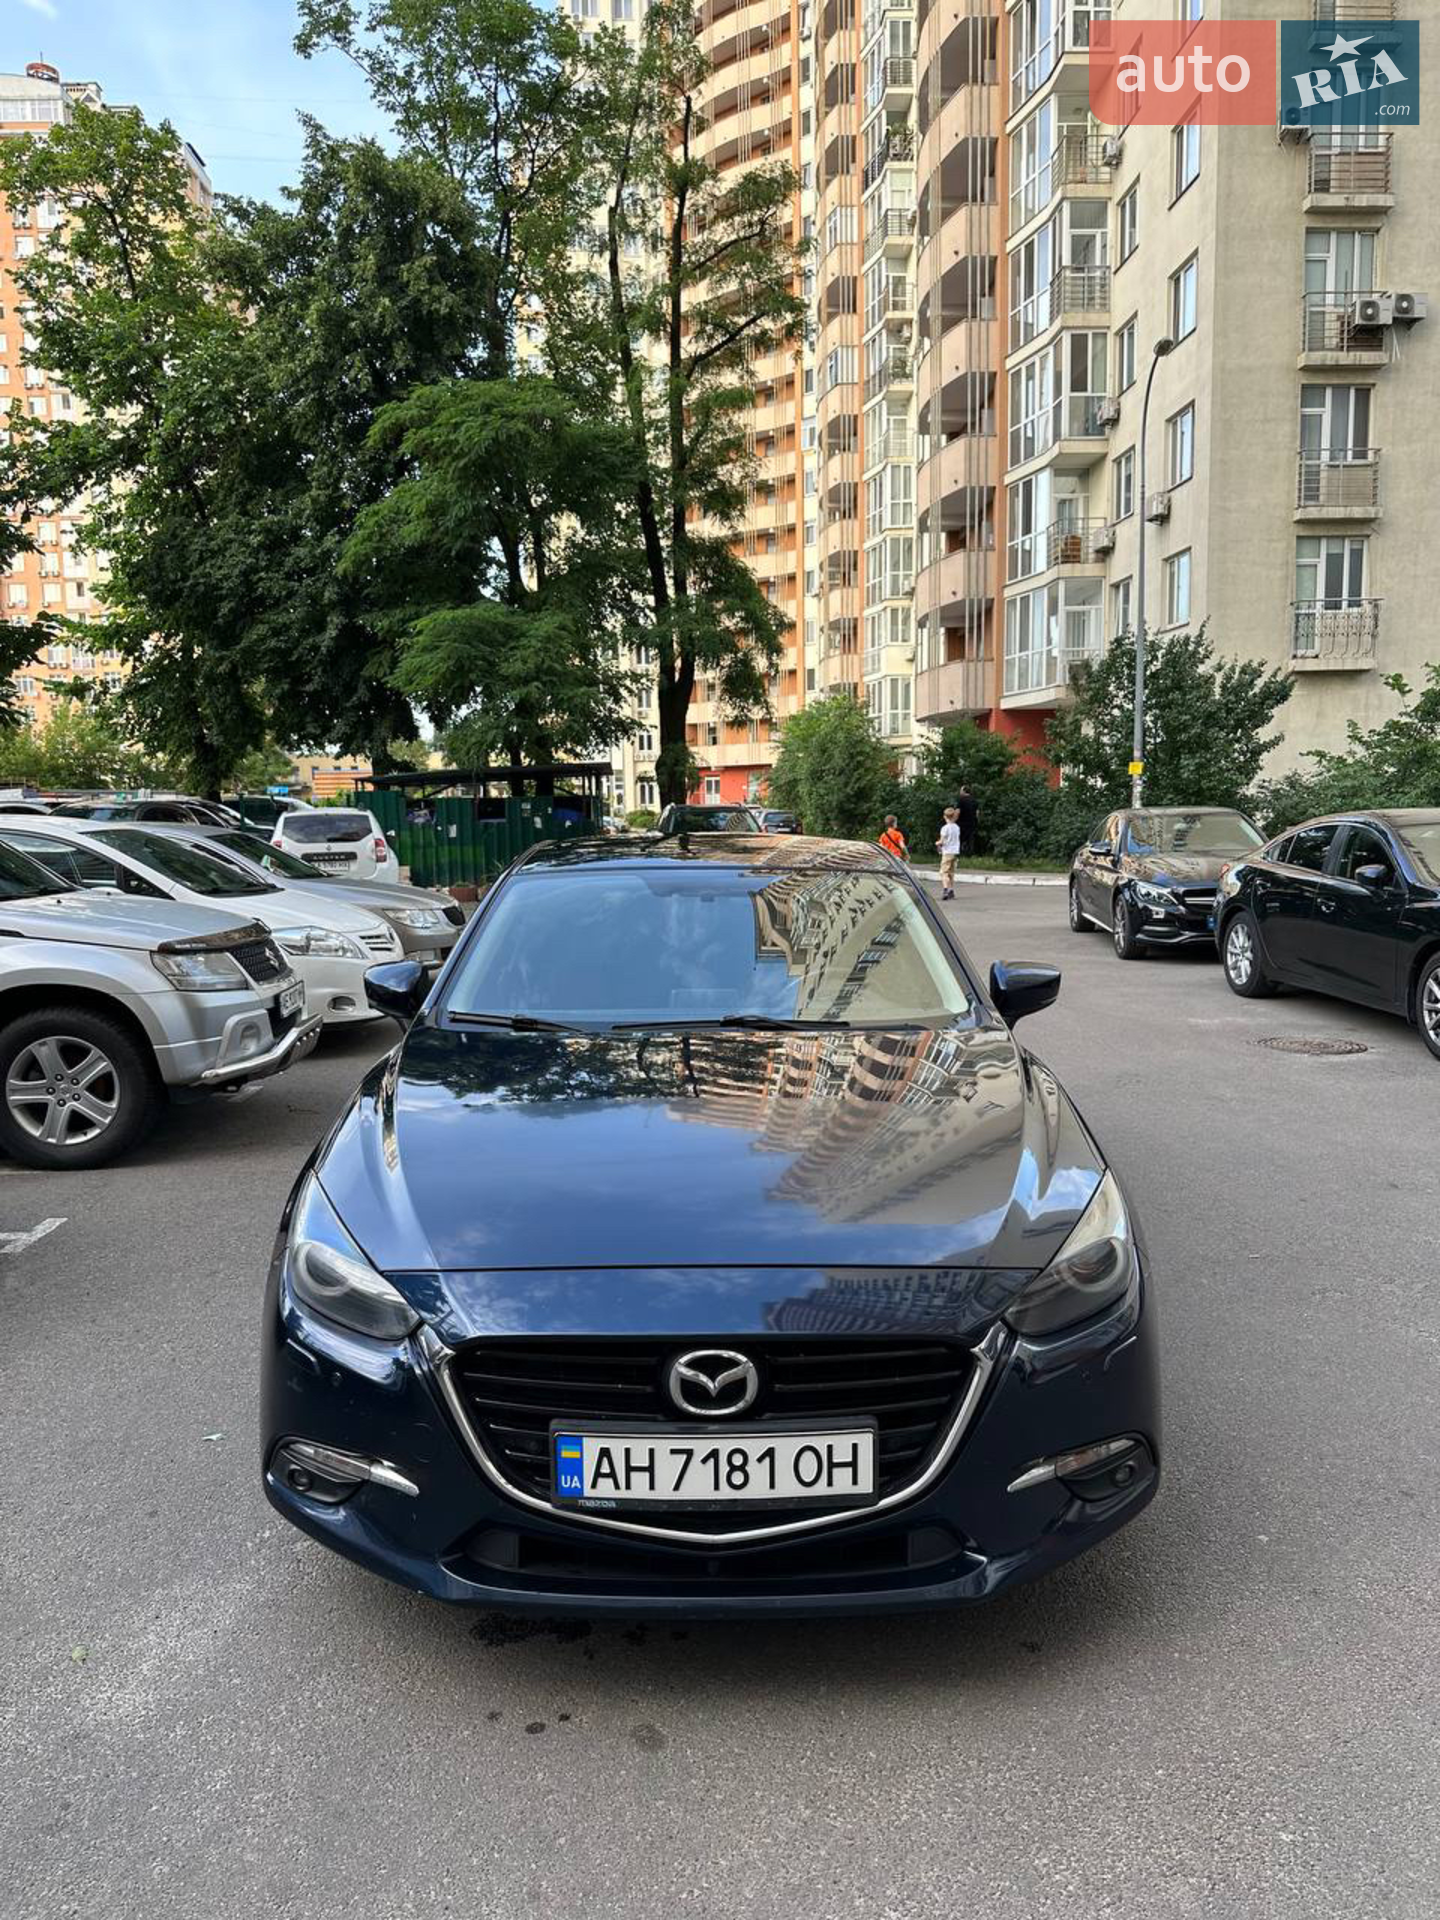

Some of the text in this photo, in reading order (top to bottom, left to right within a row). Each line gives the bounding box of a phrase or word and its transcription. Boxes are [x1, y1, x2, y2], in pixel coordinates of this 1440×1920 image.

[561, 1442, 858, 1491] UA AH 7181 OH
